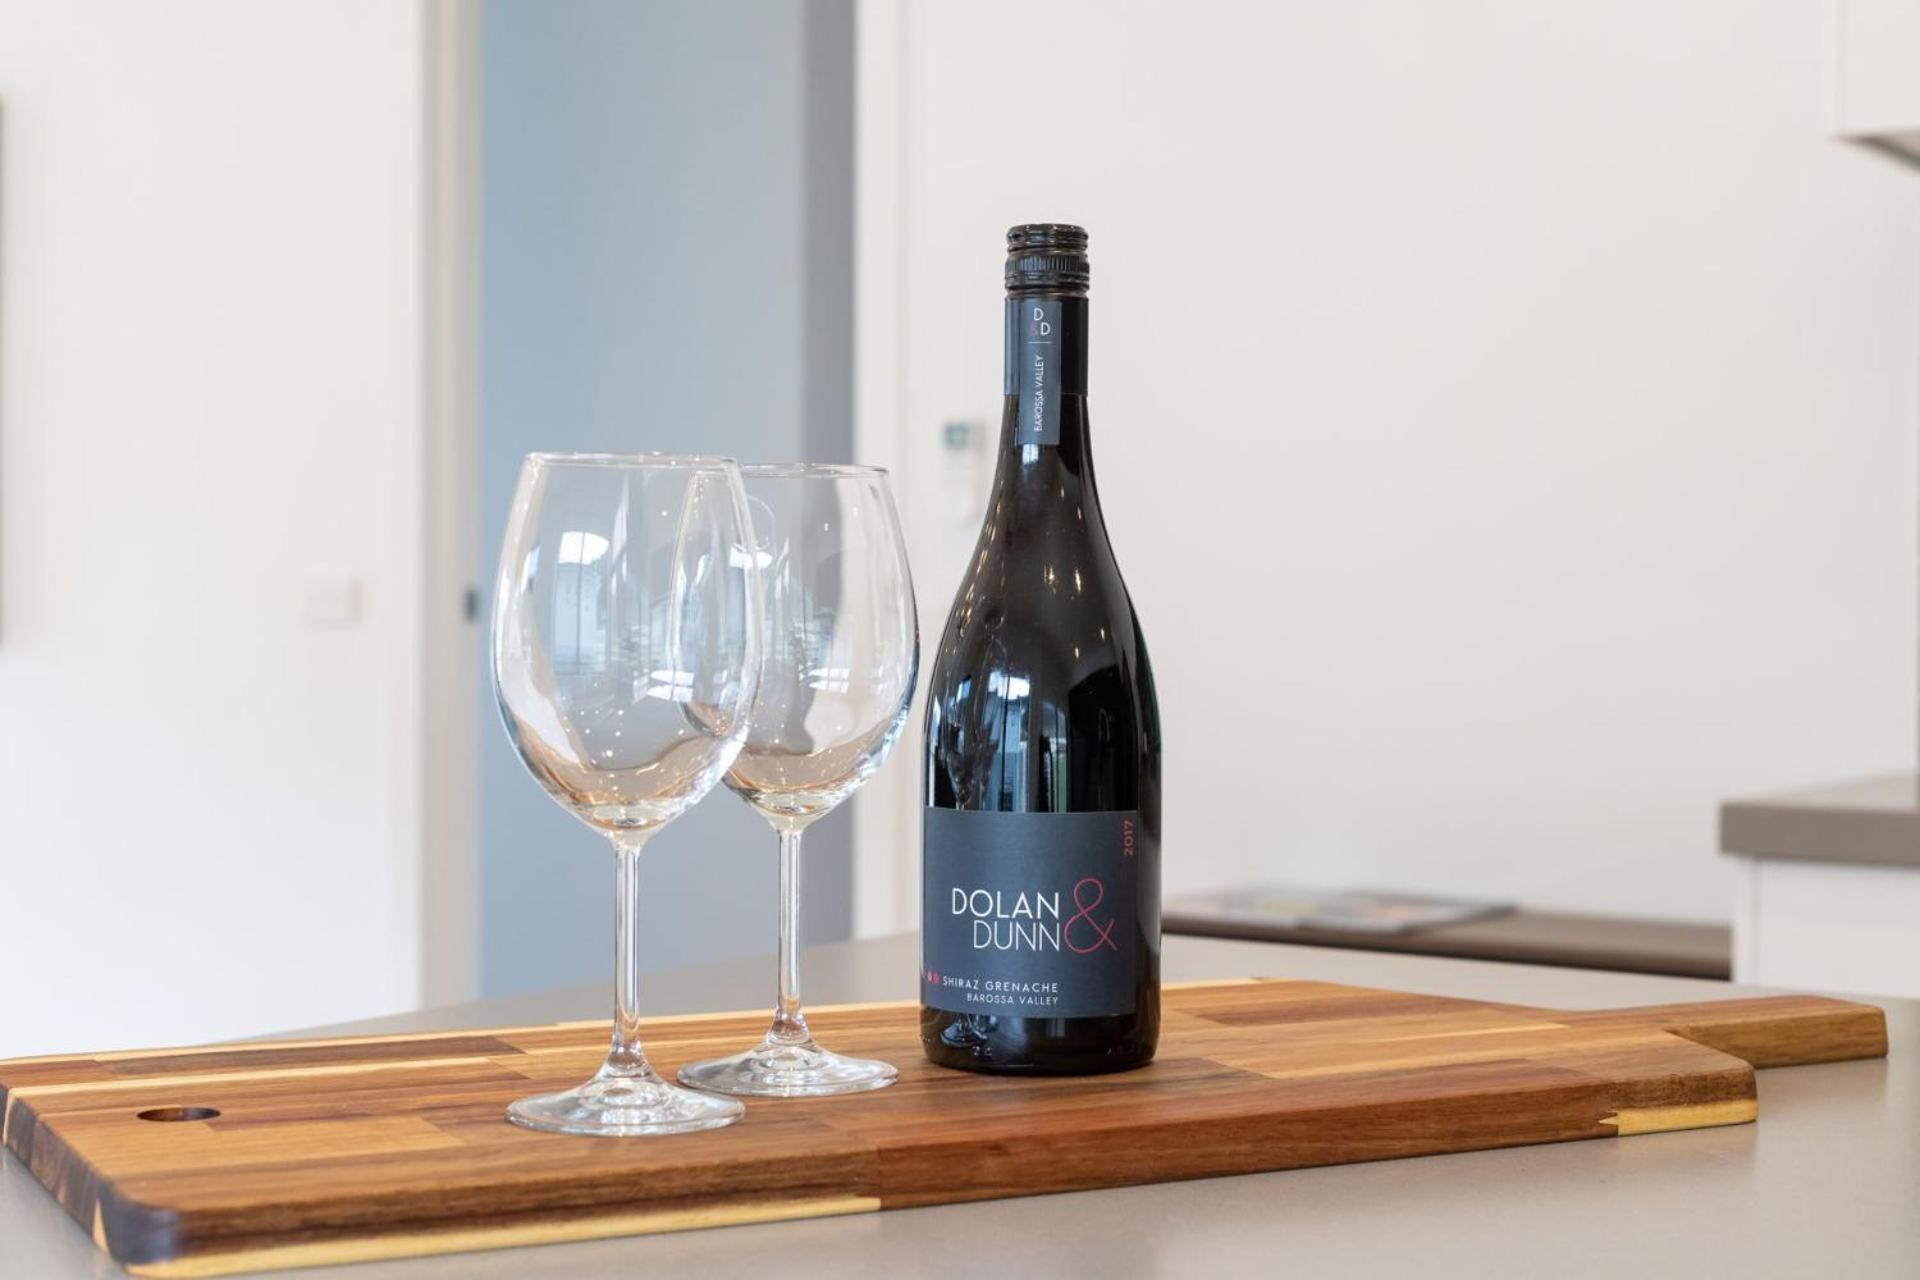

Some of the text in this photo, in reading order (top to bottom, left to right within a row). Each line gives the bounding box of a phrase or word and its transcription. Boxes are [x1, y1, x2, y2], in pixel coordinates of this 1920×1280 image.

[1033, 307, 1044, 321] D
[1040, 321, 1051, 336] D
[1033, 354, 1044, 432] BAROSSA VALLEY
[1123, 820, 1134, 857] 2017
[952, 877, 1118, 954] DOLAN &
[973, 919, 1061, 951] DUNN
[942, 975, 1059, 993] SHIRAZ GRENACHE
[966, 992, 1059, 1006] BAROSSA VALLEY
